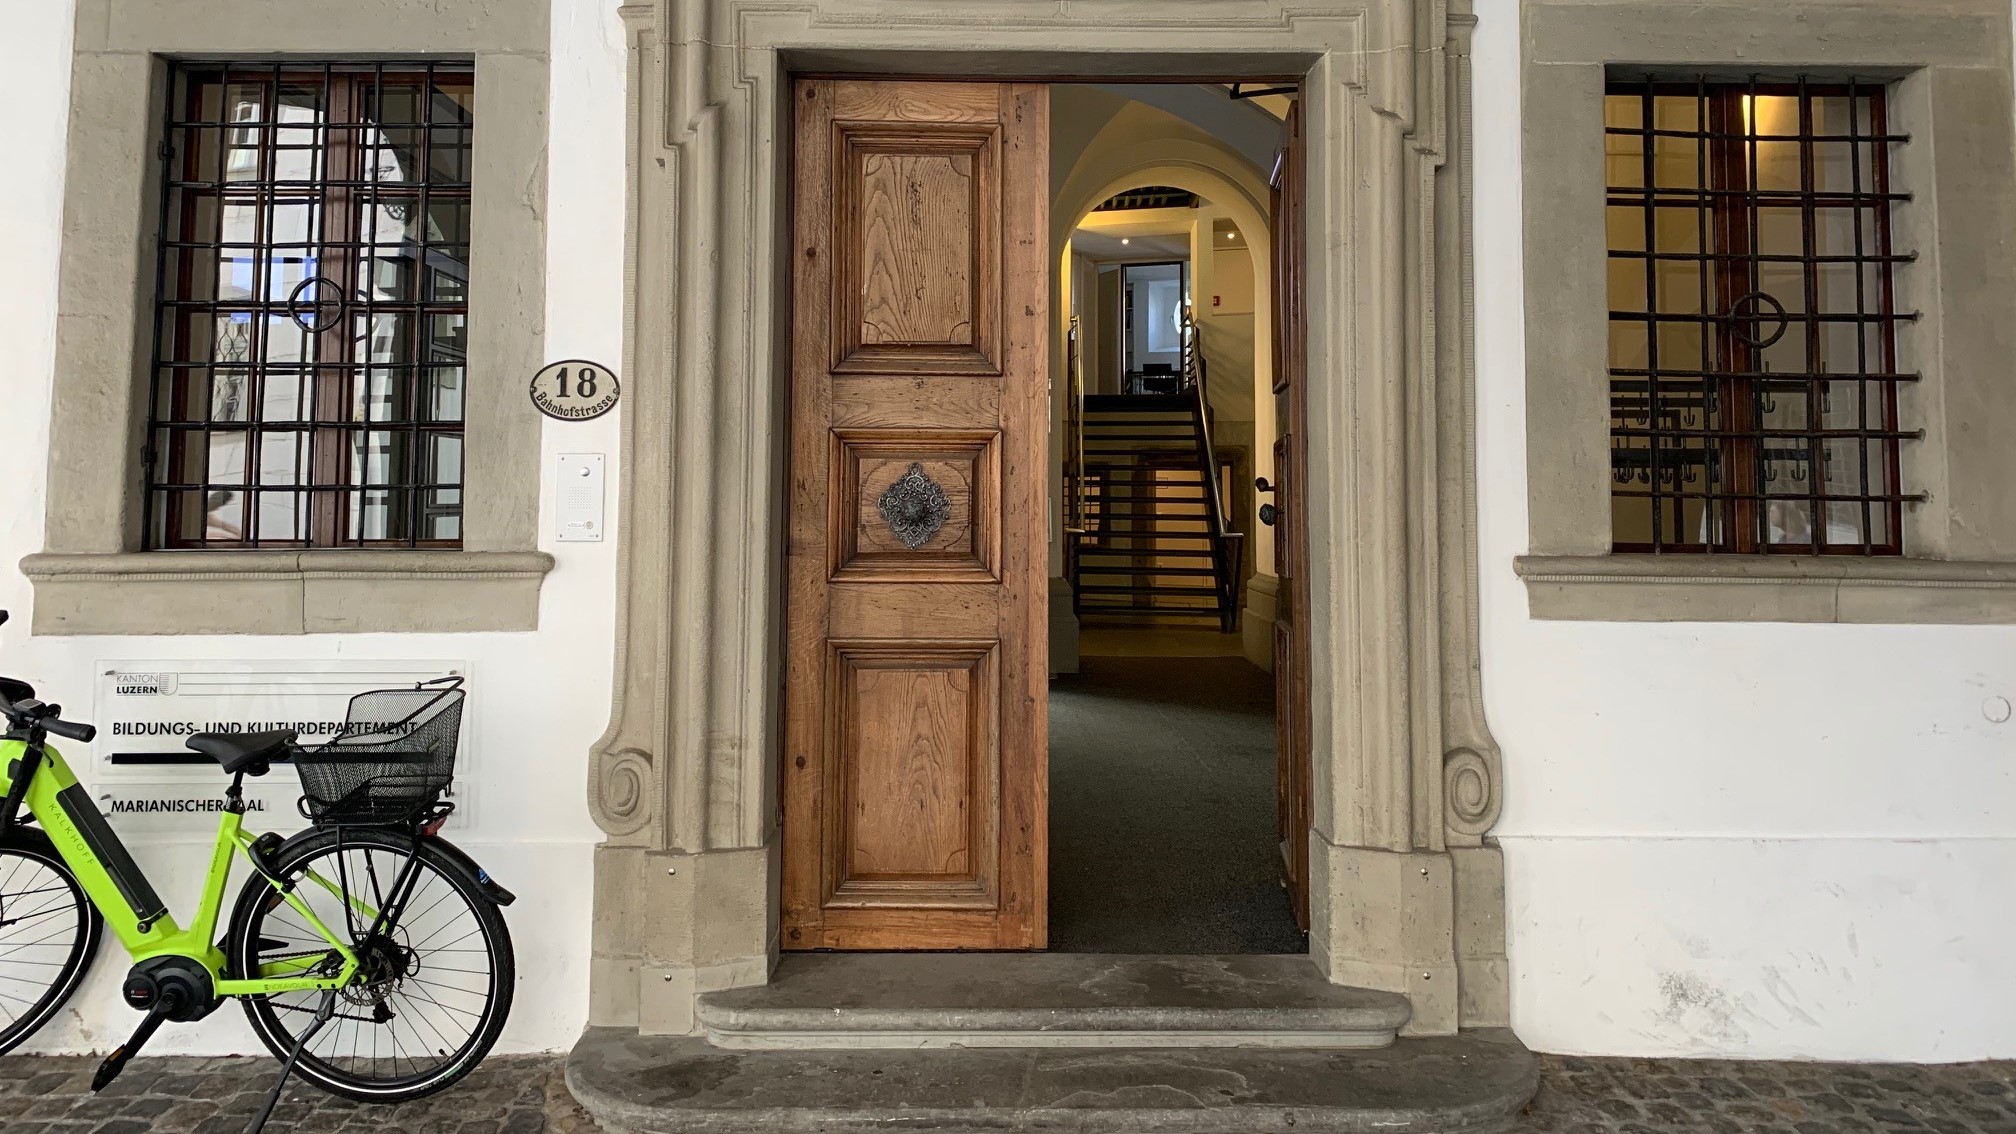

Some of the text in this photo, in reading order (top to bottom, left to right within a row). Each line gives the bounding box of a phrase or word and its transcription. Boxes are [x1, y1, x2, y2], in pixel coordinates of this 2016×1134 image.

[556, 367, 597, 398] 18
[535, 391, 613, 417] Bahnhofstrasse
[116, 674, 158, 683] KANTON
[116, 686, 158, 694] LUZERN
[205, 722, 242, 734] UND
[111, 799, 224, 812] MARIANISCHER
[48, 803, 95, 864] KALKHOFF
